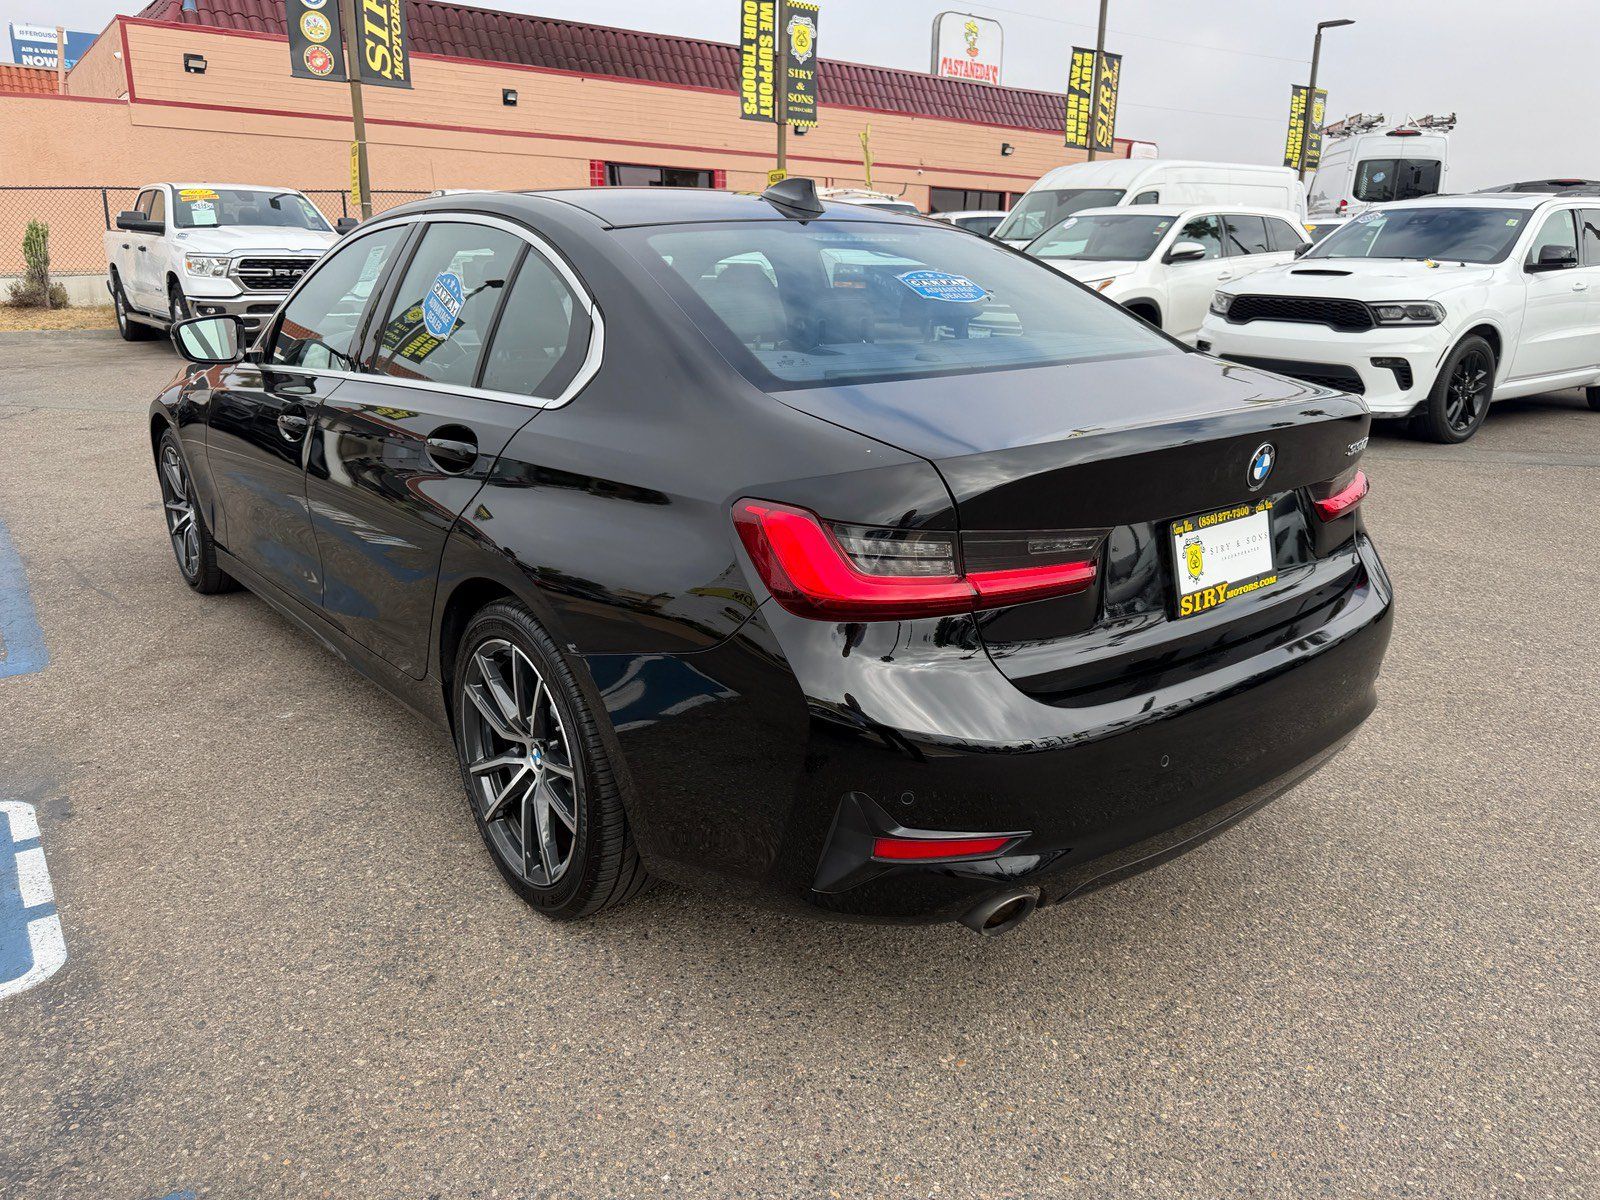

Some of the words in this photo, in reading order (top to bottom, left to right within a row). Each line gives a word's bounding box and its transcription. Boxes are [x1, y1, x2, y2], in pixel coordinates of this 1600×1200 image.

[743, 0, 758, 40] OUR
[759, 2, 774, 32] WE
[22, 54, 58, 68] NOW
[758, 34, 774, 118] SUPPORT
[787, 68, 814, 80] SIRY
[1070, 53, 1083, 91] PAY
[1080, 52, 1093, 94] BUY
[742, 43, 758, 115] TROOPS
[796, 82, 805, 91] &
[787, 93, 814, 104] SONS
[1096, 56, 1112, 147] SIRY
[1290, 95, 1300, 128] AUTO
[1066, 94, 1079, 143] HERE
[1076, 97, 1090, 146] HERE
[1286, 128, 1296, 159] CARE
[1291, 119, 1304, 168] SERVICE
[275, 268, 306, 276] RA
[1210, 542, 1231, 556] SIRY
[1246, 532, 1268, 545] SONS
